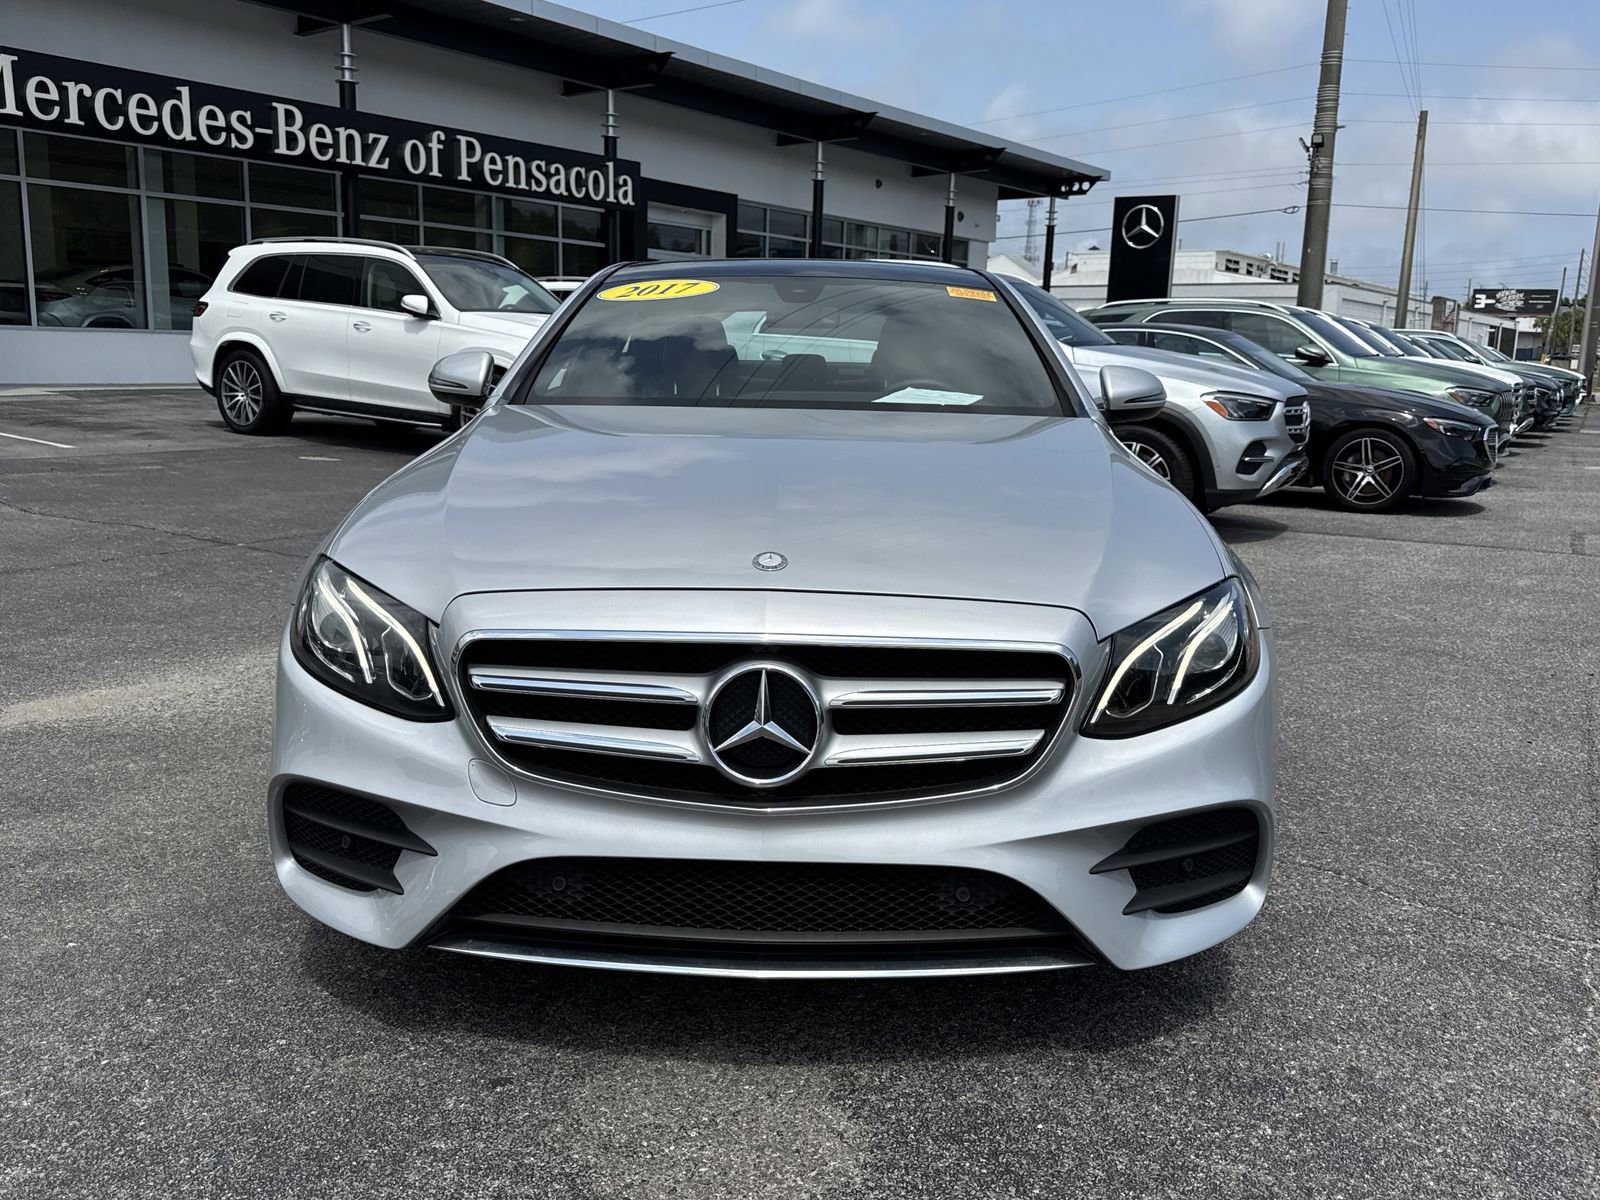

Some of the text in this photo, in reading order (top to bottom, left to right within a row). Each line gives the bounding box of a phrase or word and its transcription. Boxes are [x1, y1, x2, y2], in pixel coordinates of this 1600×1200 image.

[403, 130, 446, 178] of
[455, 134, 636, 206] Pensacola
[614, 282, 701, 299] 2017
